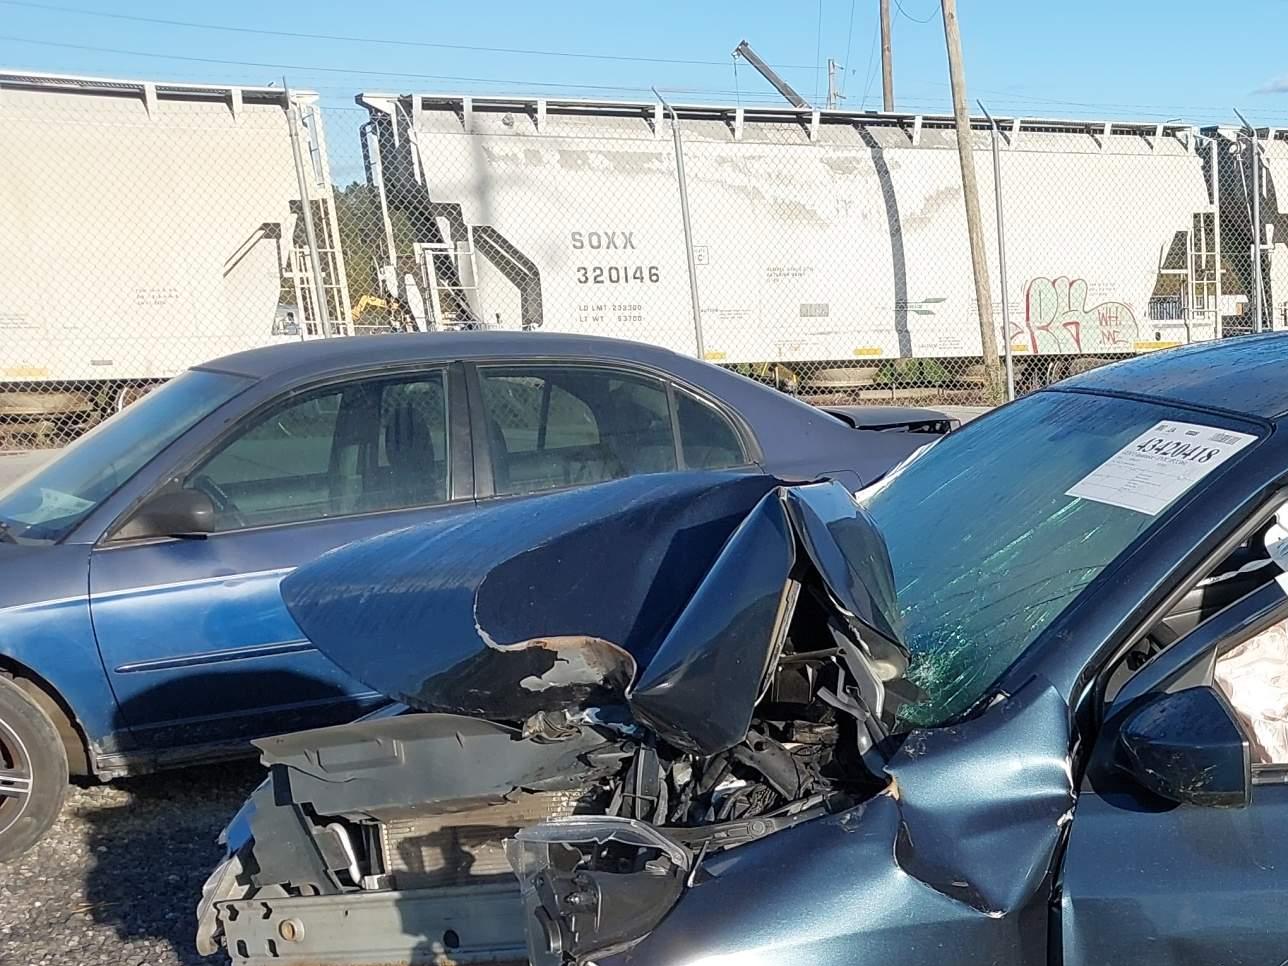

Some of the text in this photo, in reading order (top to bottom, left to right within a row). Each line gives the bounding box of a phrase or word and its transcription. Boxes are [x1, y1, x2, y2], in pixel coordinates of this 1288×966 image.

[571, 231, 636, 250] SOXX
[576, 265, 660, 284] 320146
[1136, 436, 1220, 463] 43420418
